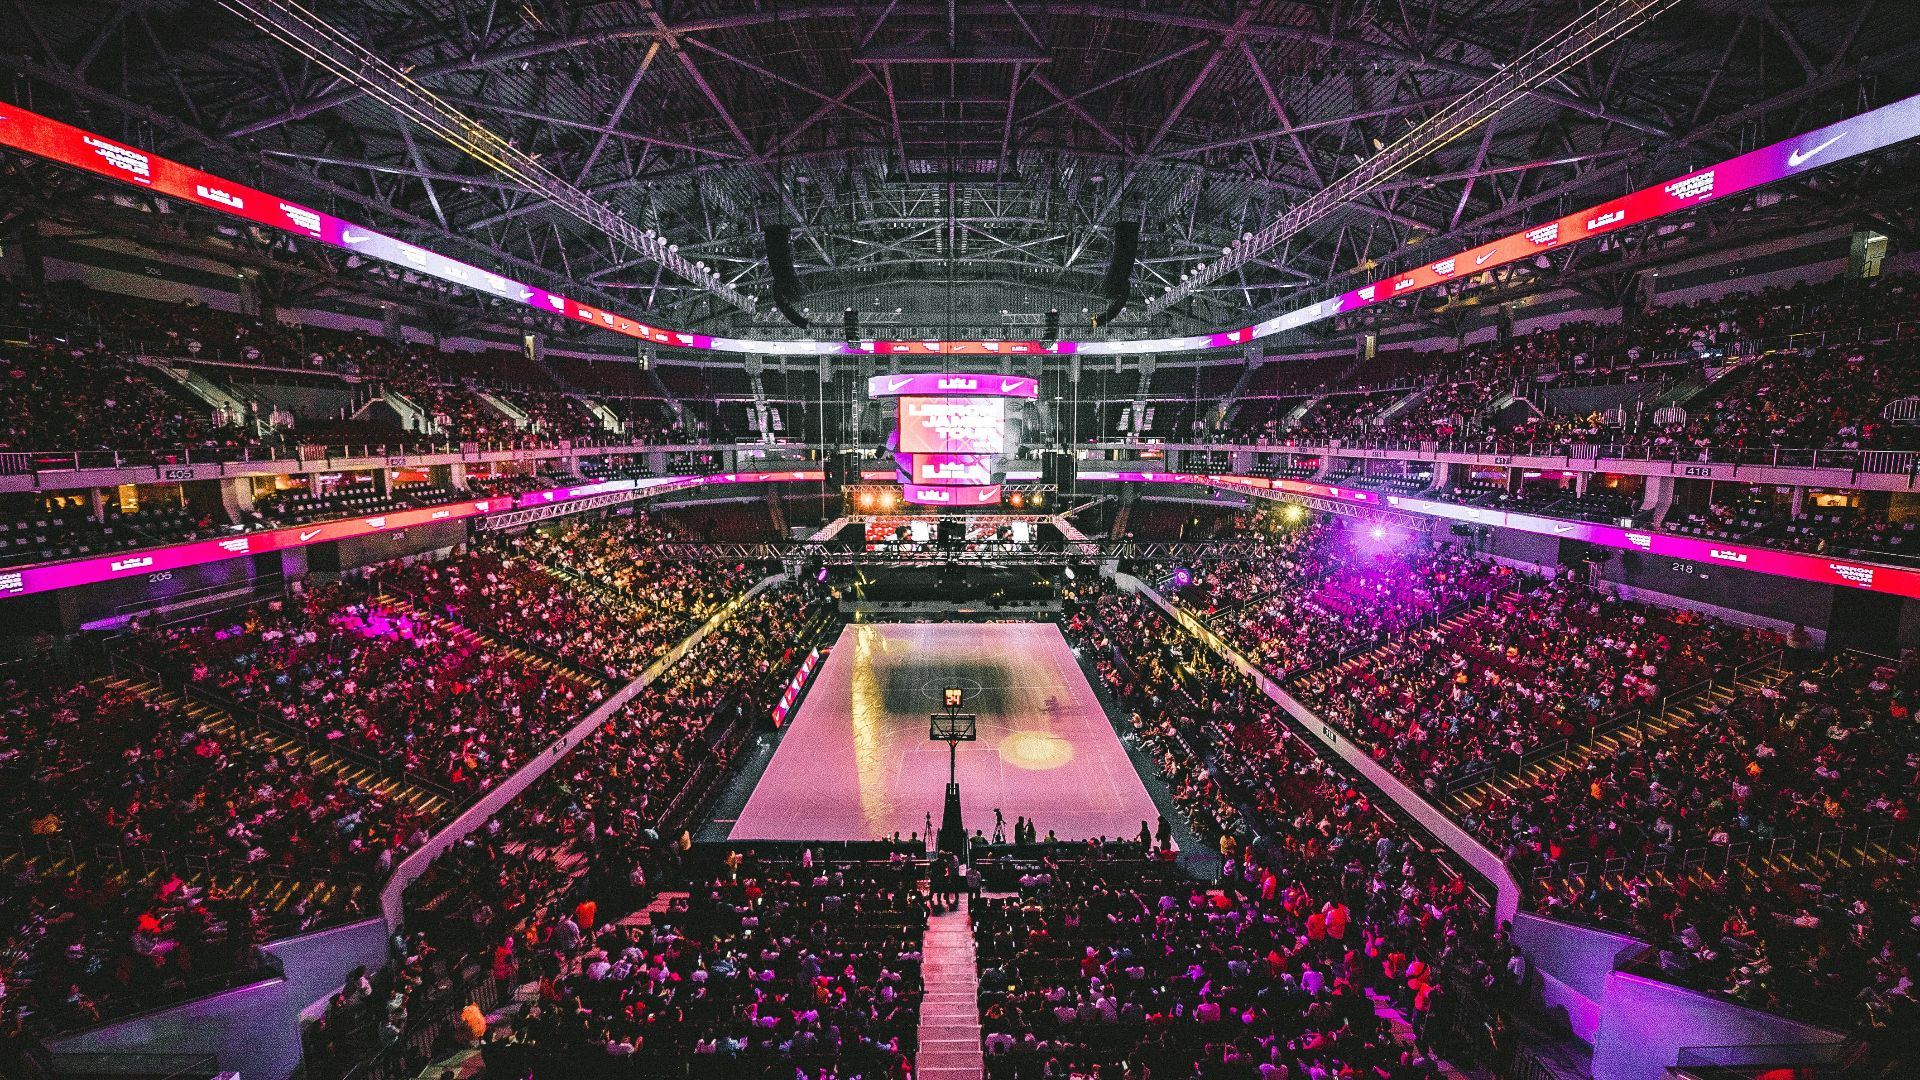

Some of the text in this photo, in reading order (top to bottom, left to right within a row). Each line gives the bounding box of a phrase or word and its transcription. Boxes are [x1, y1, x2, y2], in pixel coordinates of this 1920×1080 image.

[1664, 170, 1715, 193] LEBRON
[1679, 184, 1713, 200] TOUR
[169, 470, 191, 479] 405
[1687, 467, 1709, 476] 418
[1672, 562, 1693, 574] 218
[149, 571, 173, 583] 205
[946, 695, 960, 706] 24
